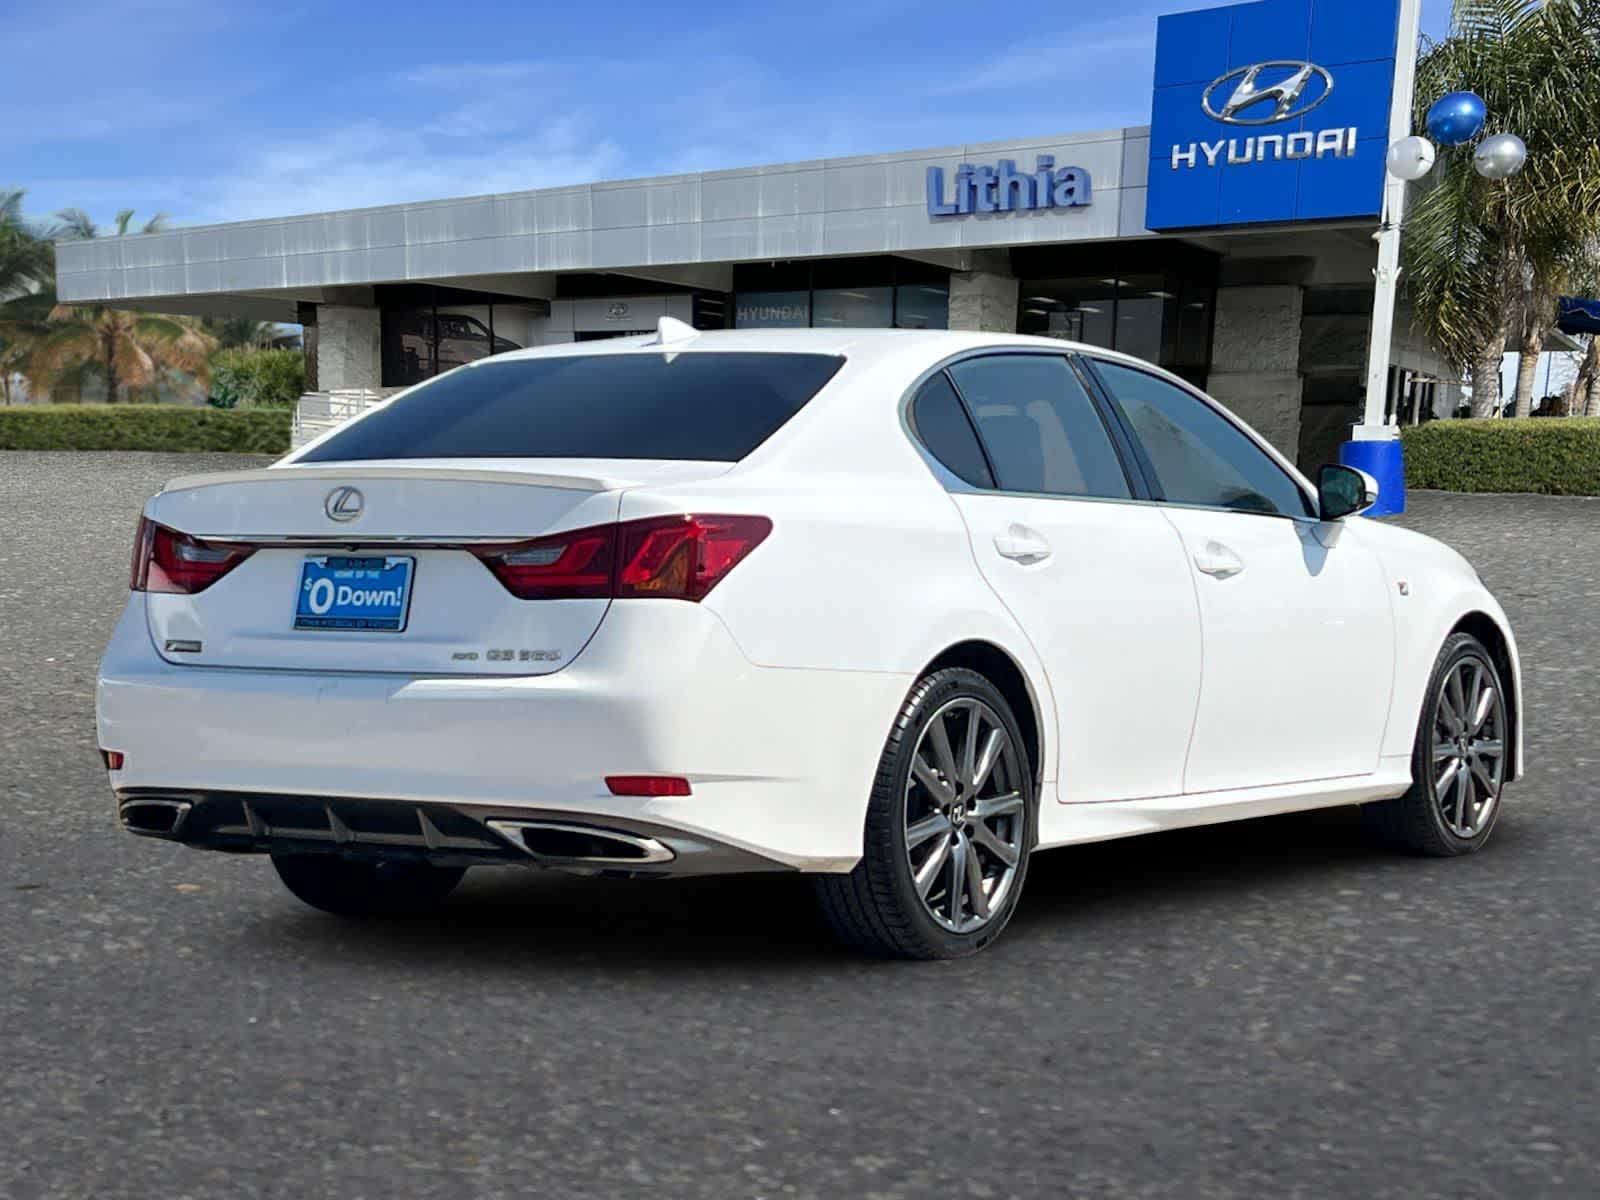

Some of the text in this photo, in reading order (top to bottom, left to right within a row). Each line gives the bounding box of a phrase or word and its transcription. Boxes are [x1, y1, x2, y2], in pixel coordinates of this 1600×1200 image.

[1171, 127, 1357, 169] HYUNDAI
[926, 155, 1093, 217] Lithia
[736, 304, 809, 321] HYUNDAI
[336, 585, 402, 607] Down!
